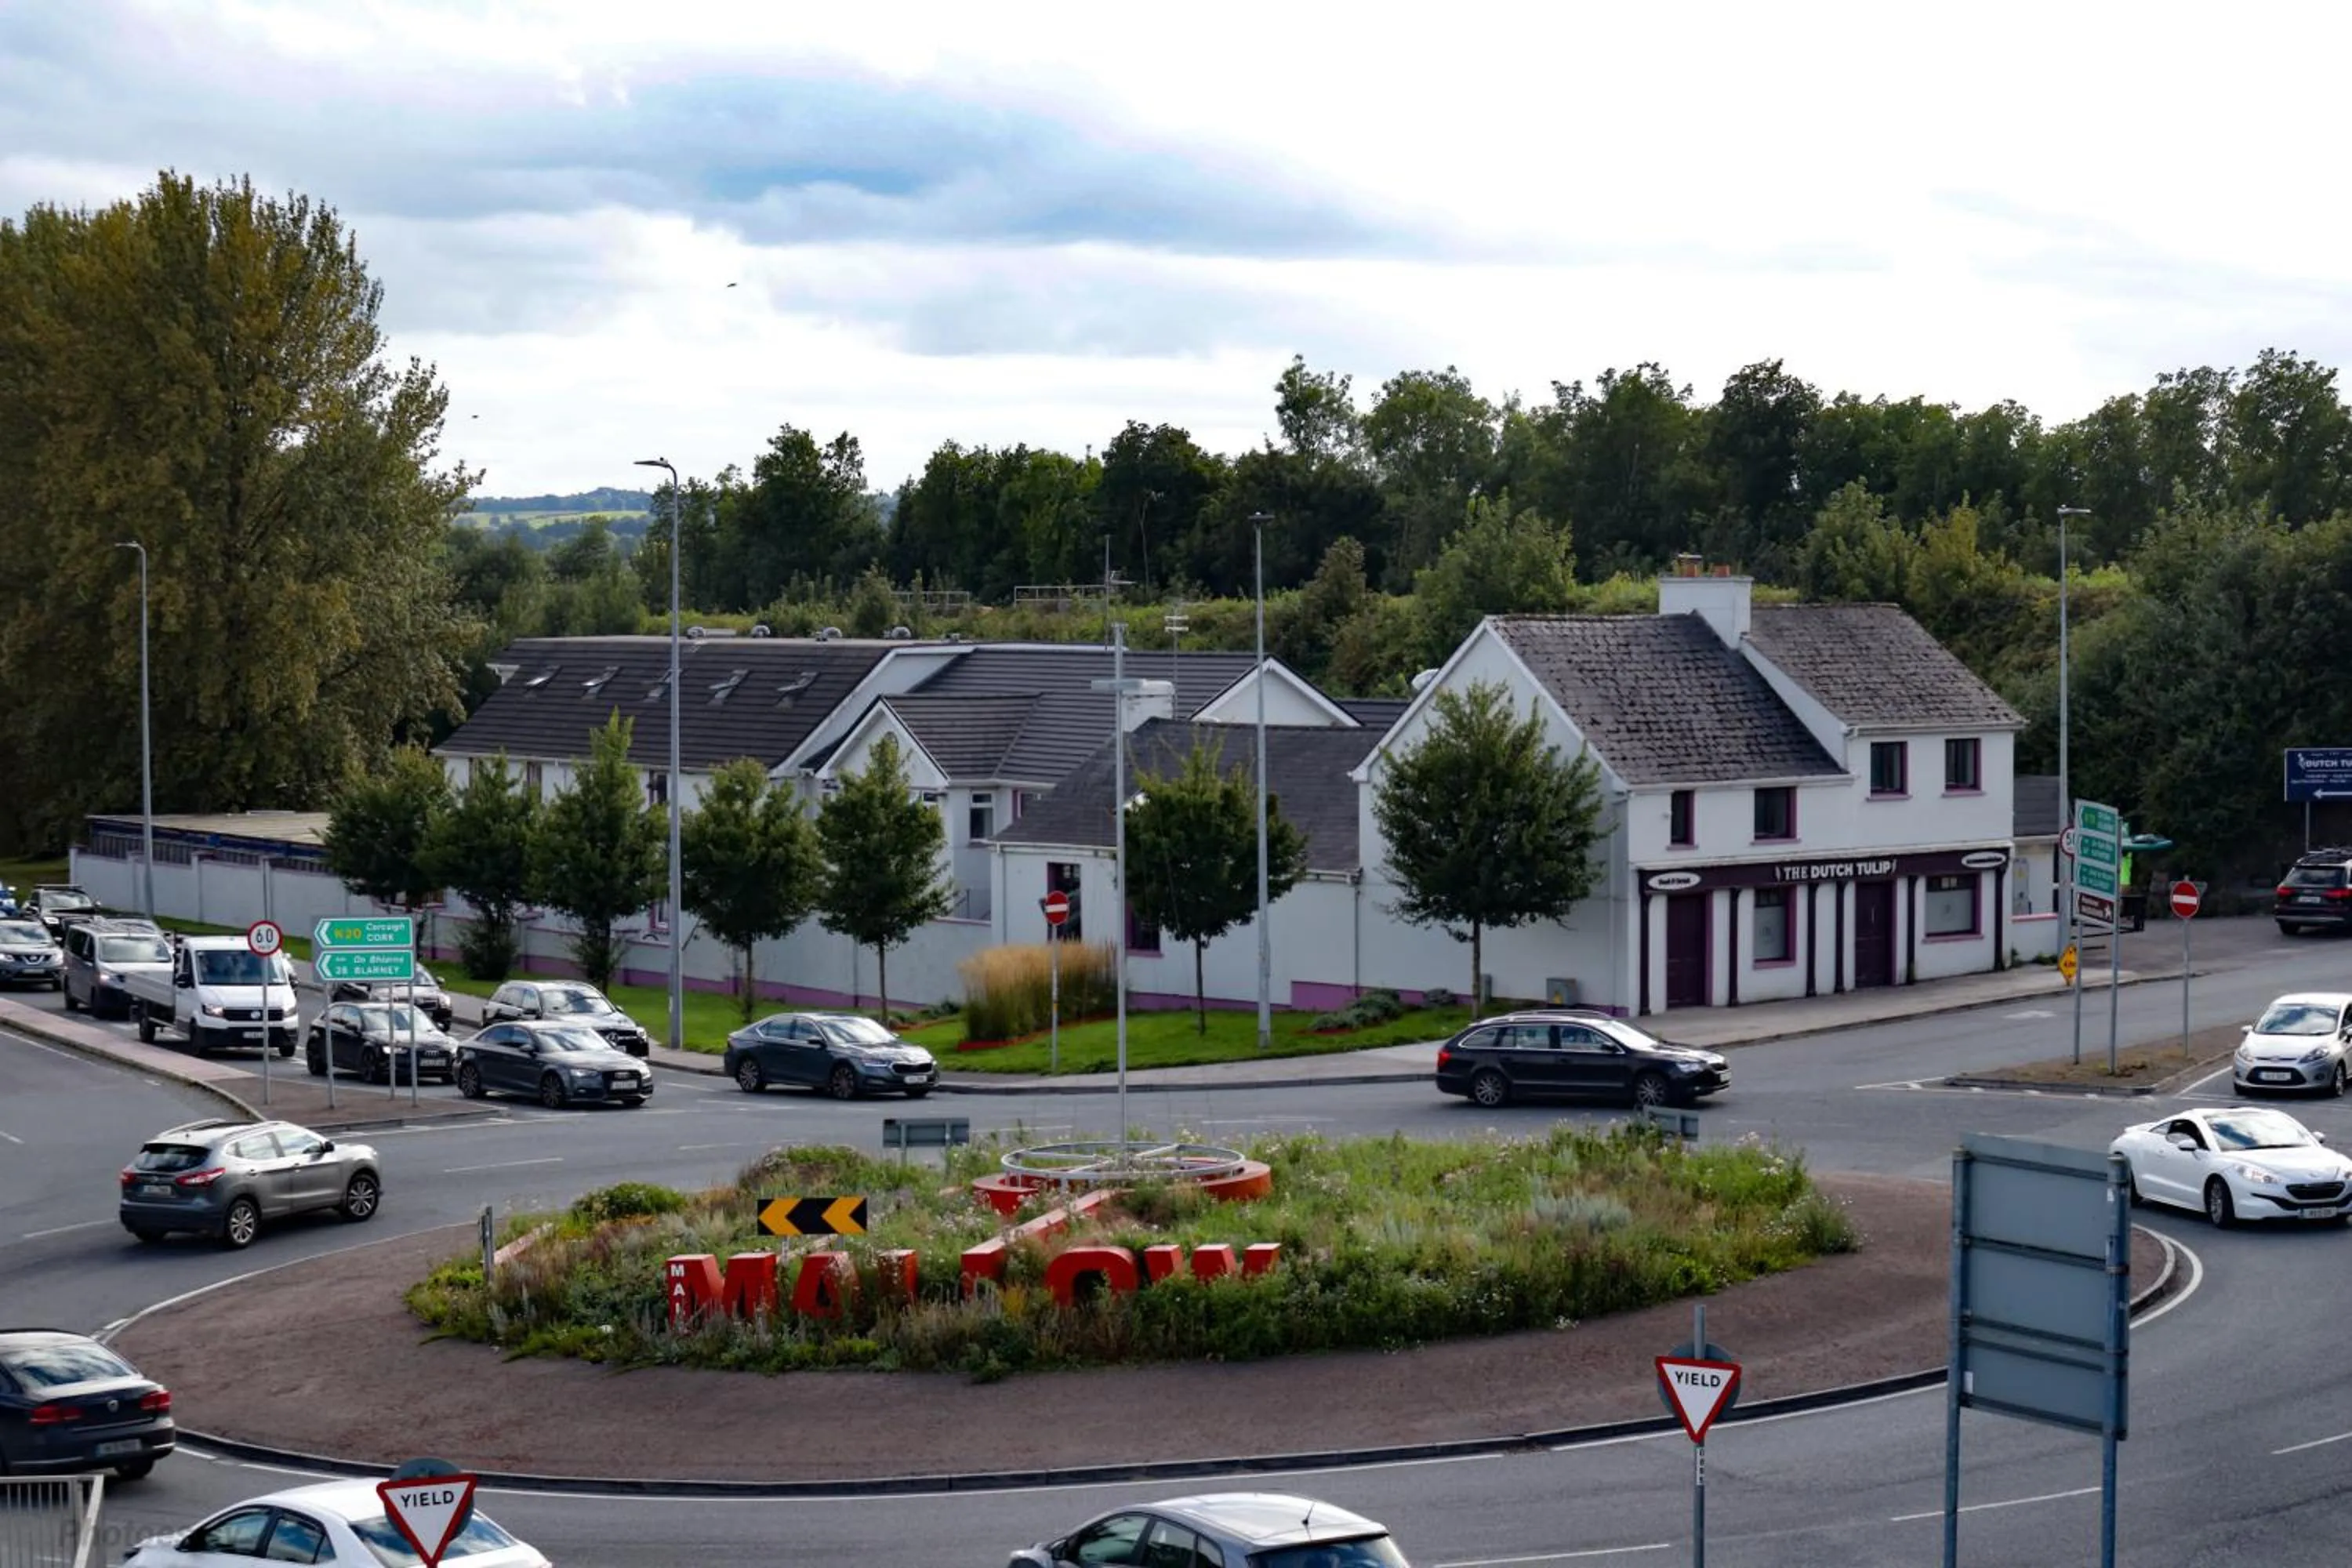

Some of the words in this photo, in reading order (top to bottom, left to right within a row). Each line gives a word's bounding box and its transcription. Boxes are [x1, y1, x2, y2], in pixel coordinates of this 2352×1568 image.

[1784, 866, 1808, 880] THE
[1810, 863, 1853, 879] DUTCH
[1857, 861, 1890, 874] TULIP
[256, 928, 274, 943] 60
[366, 933, 394, 942] CORK
[354, 966, 399, 975] BLARNEY
[1675, 1370, 1721, 1388] YIELD
[401, 1490, 455, 1508] YIELD
